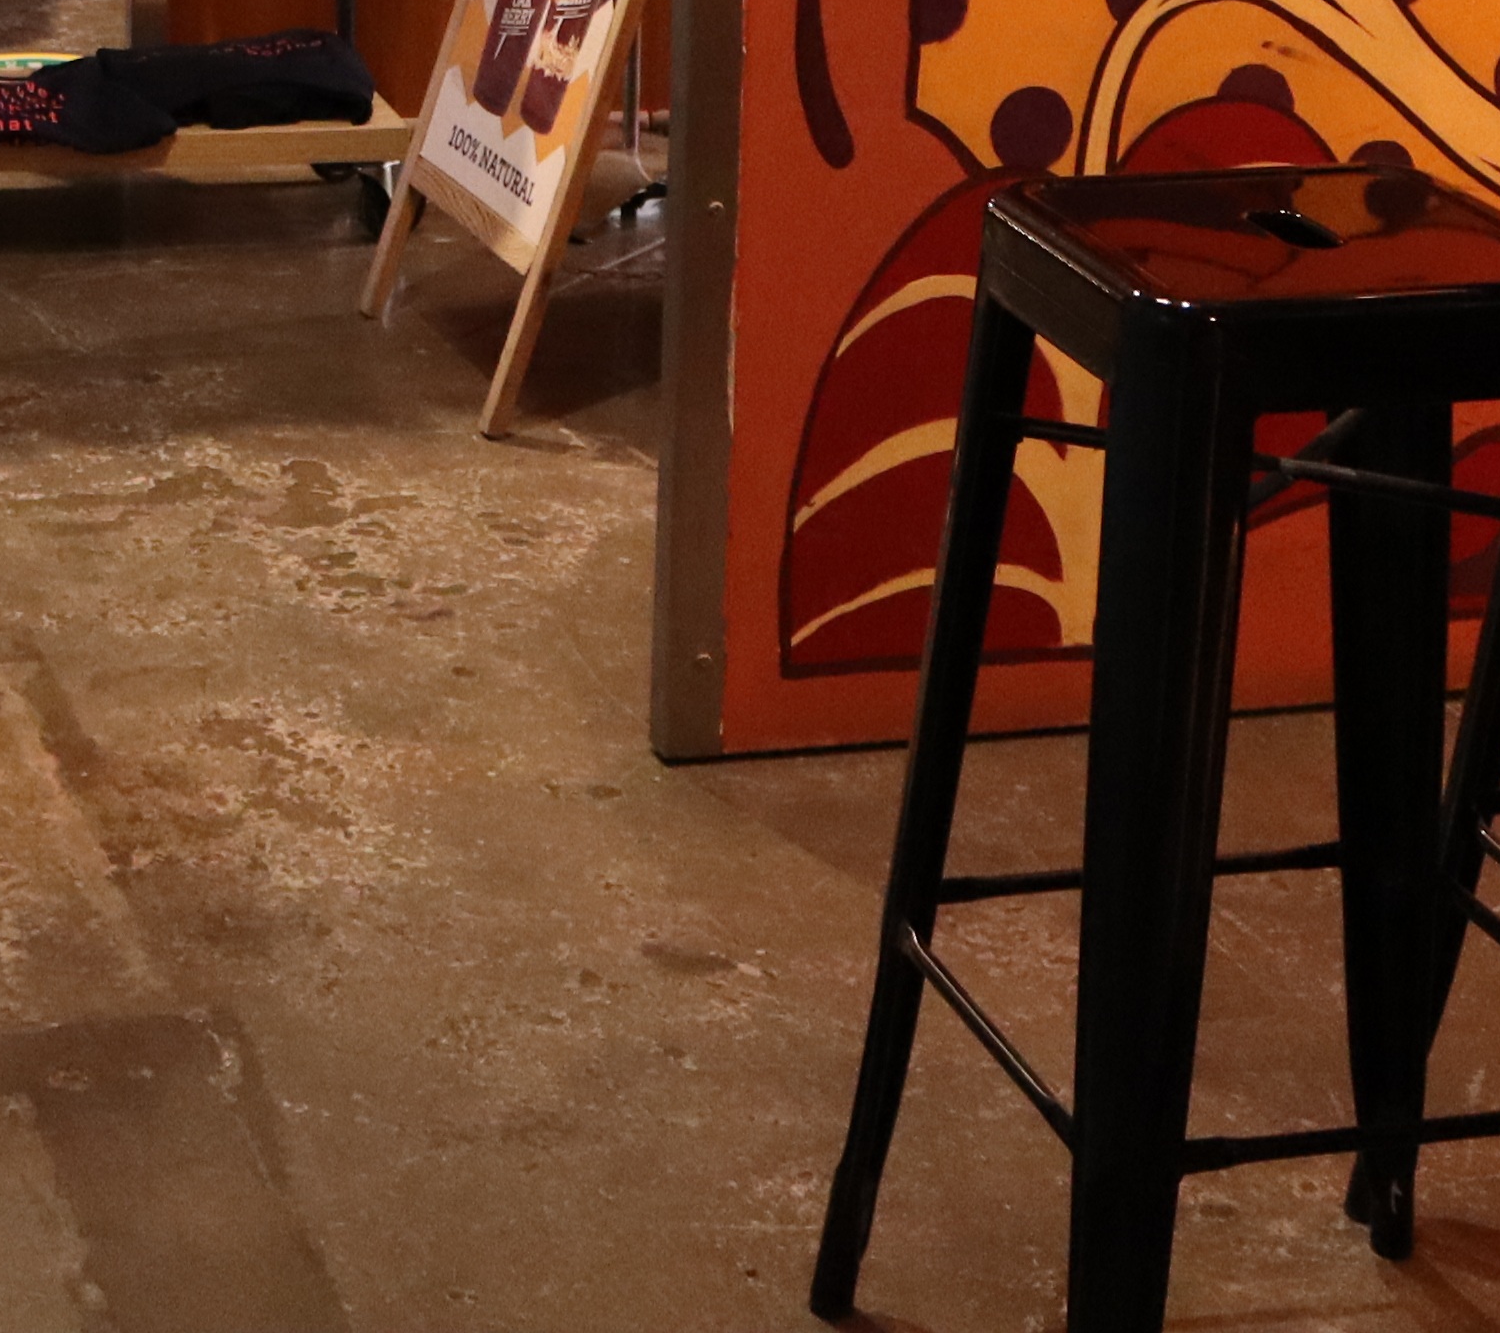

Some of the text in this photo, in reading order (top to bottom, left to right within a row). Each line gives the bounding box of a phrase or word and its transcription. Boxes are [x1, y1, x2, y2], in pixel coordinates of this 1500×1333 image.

[501, 7, 536, 26] BERRY
[448, 124, 536, 207] 100% NATURAL
